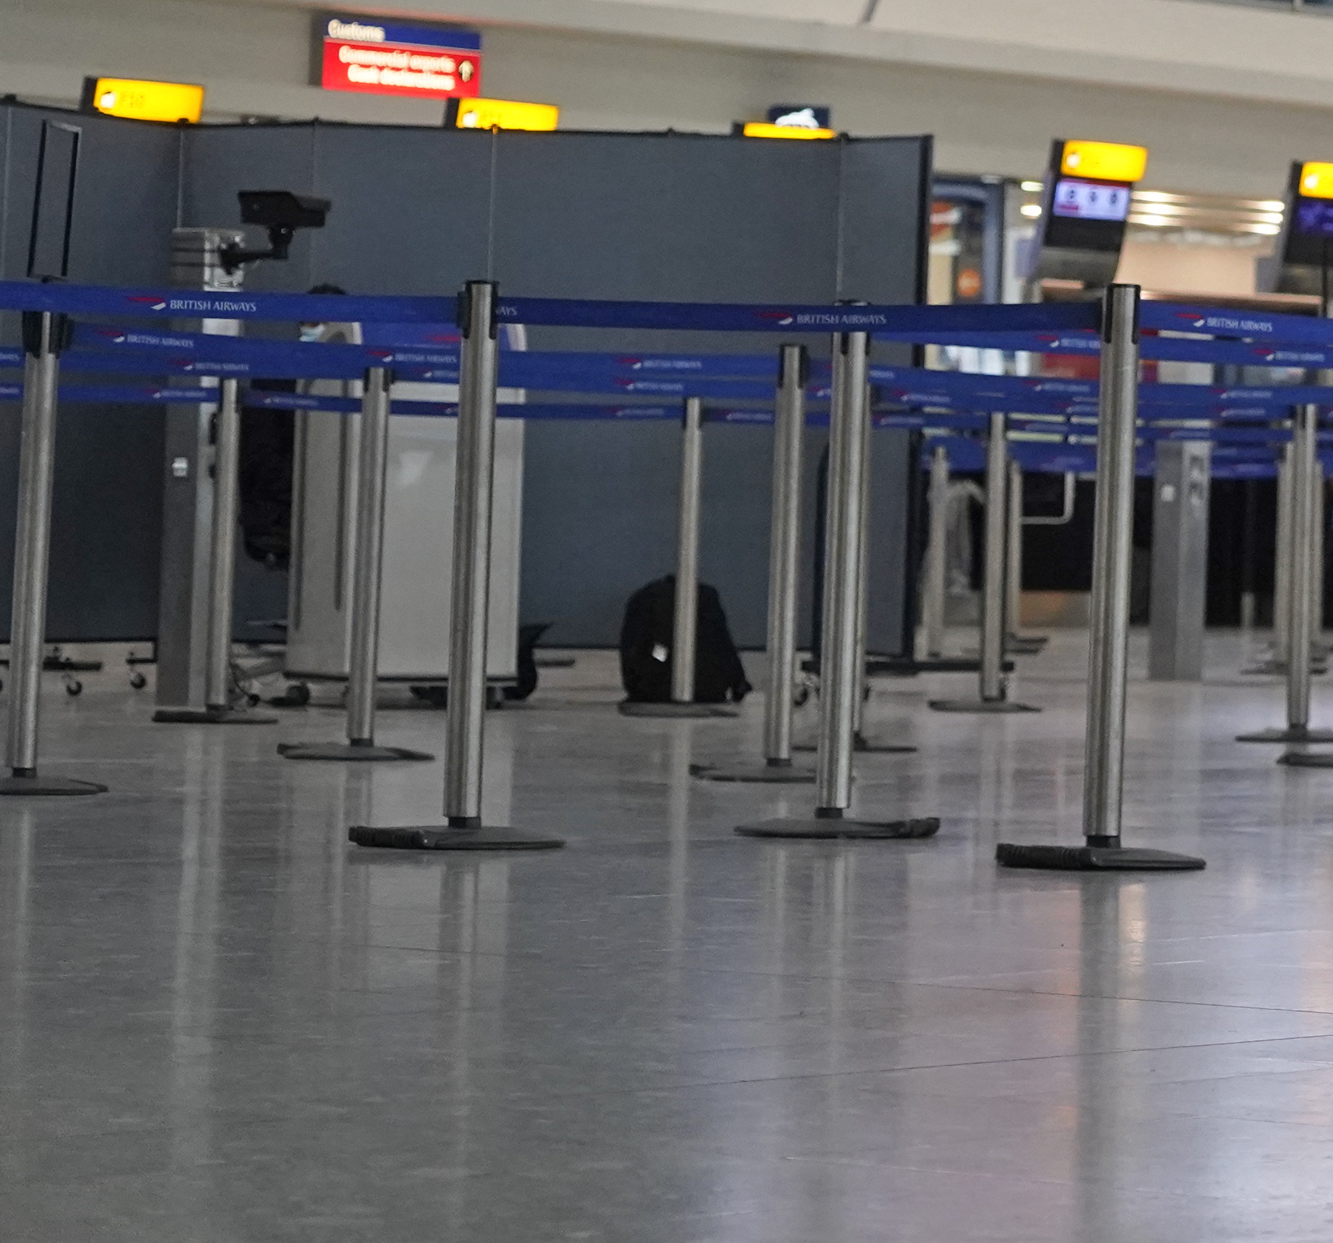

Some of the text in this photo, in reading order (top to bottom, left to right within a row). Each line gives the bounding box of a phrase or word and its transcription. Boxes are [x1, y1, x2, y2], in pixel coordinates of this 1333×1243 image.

[327, 18, 386, 43] Customs
[170, 299, 257, 313] BRITISH AIRWAYS
[796, 314, 887, 325] BRITISH AIRWAYS
[1206, 317, 1273, 332] BRITISH AIRWAYS
[126, 334, 194, 348] BRITISH AIRWAYS
